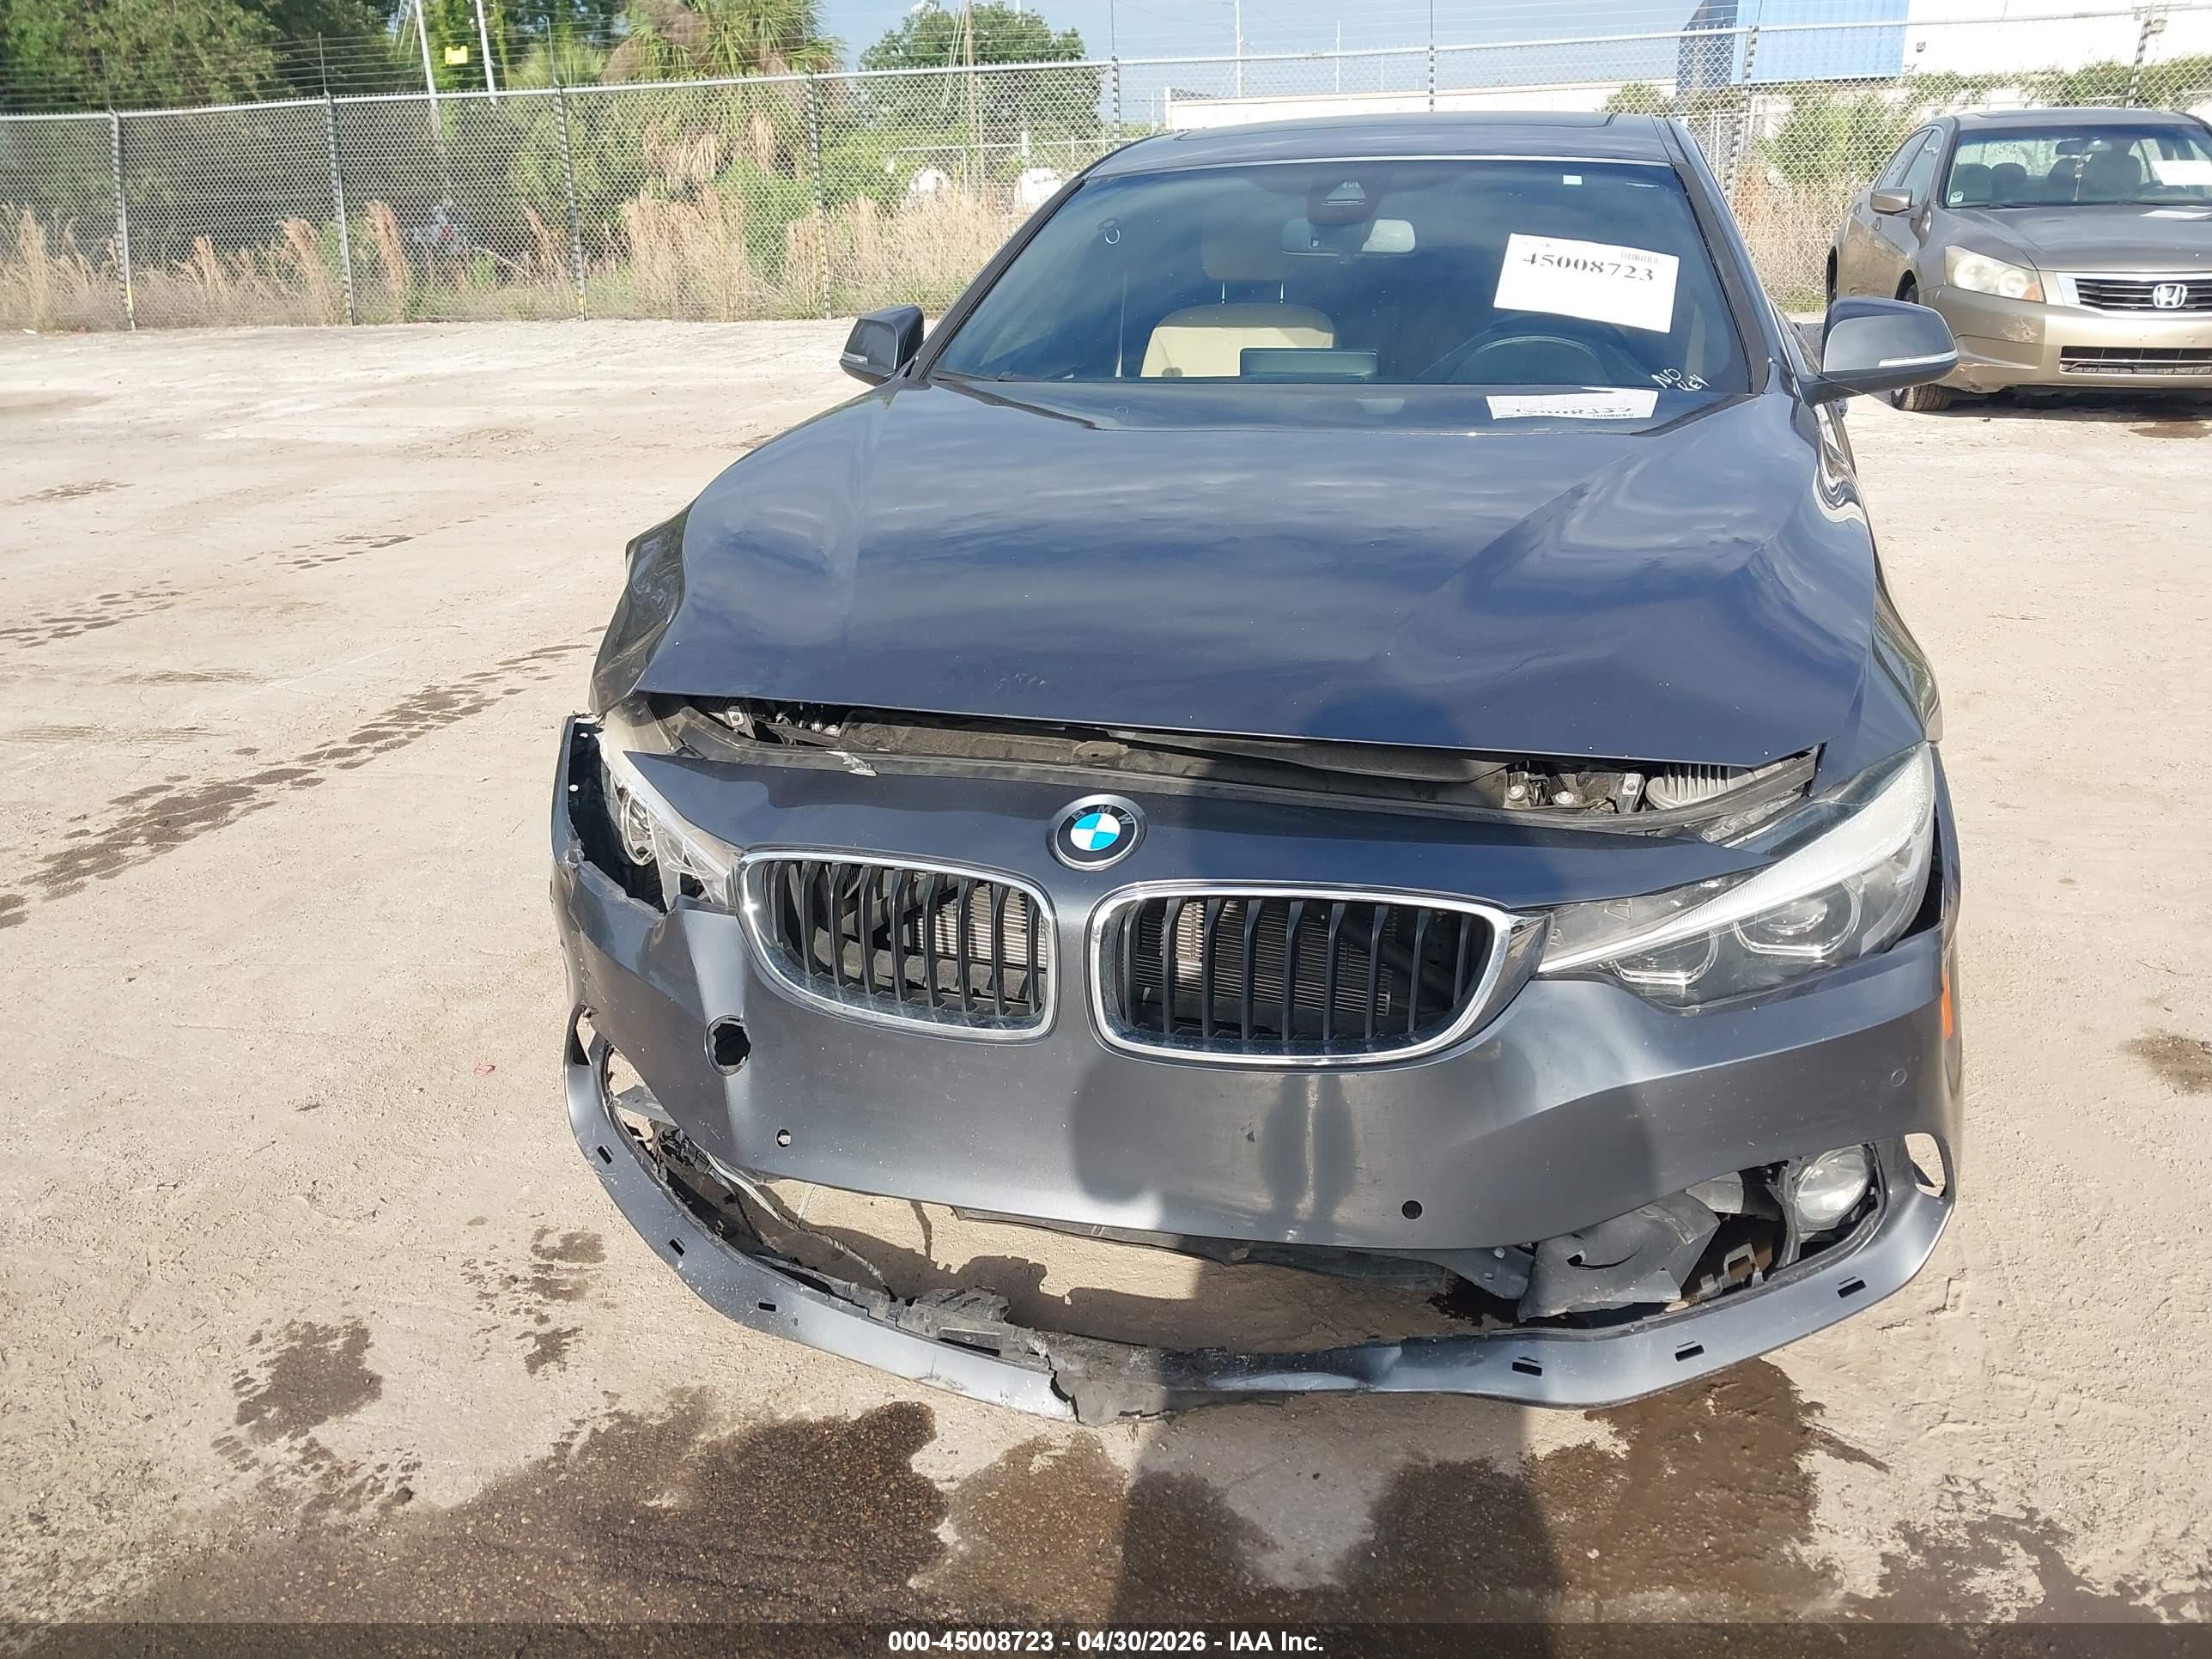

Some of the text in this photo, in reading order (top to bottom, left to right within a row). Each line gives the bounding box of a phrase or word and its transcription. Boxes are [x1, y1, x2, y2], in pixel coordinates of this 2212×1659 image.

[1523, 252, 1655, 282] 45008723
[1651, 368, 1681, 389] NO
[1677, 374, 1711, 392] KEY
[1071, 804, 1133, 826] BMW
